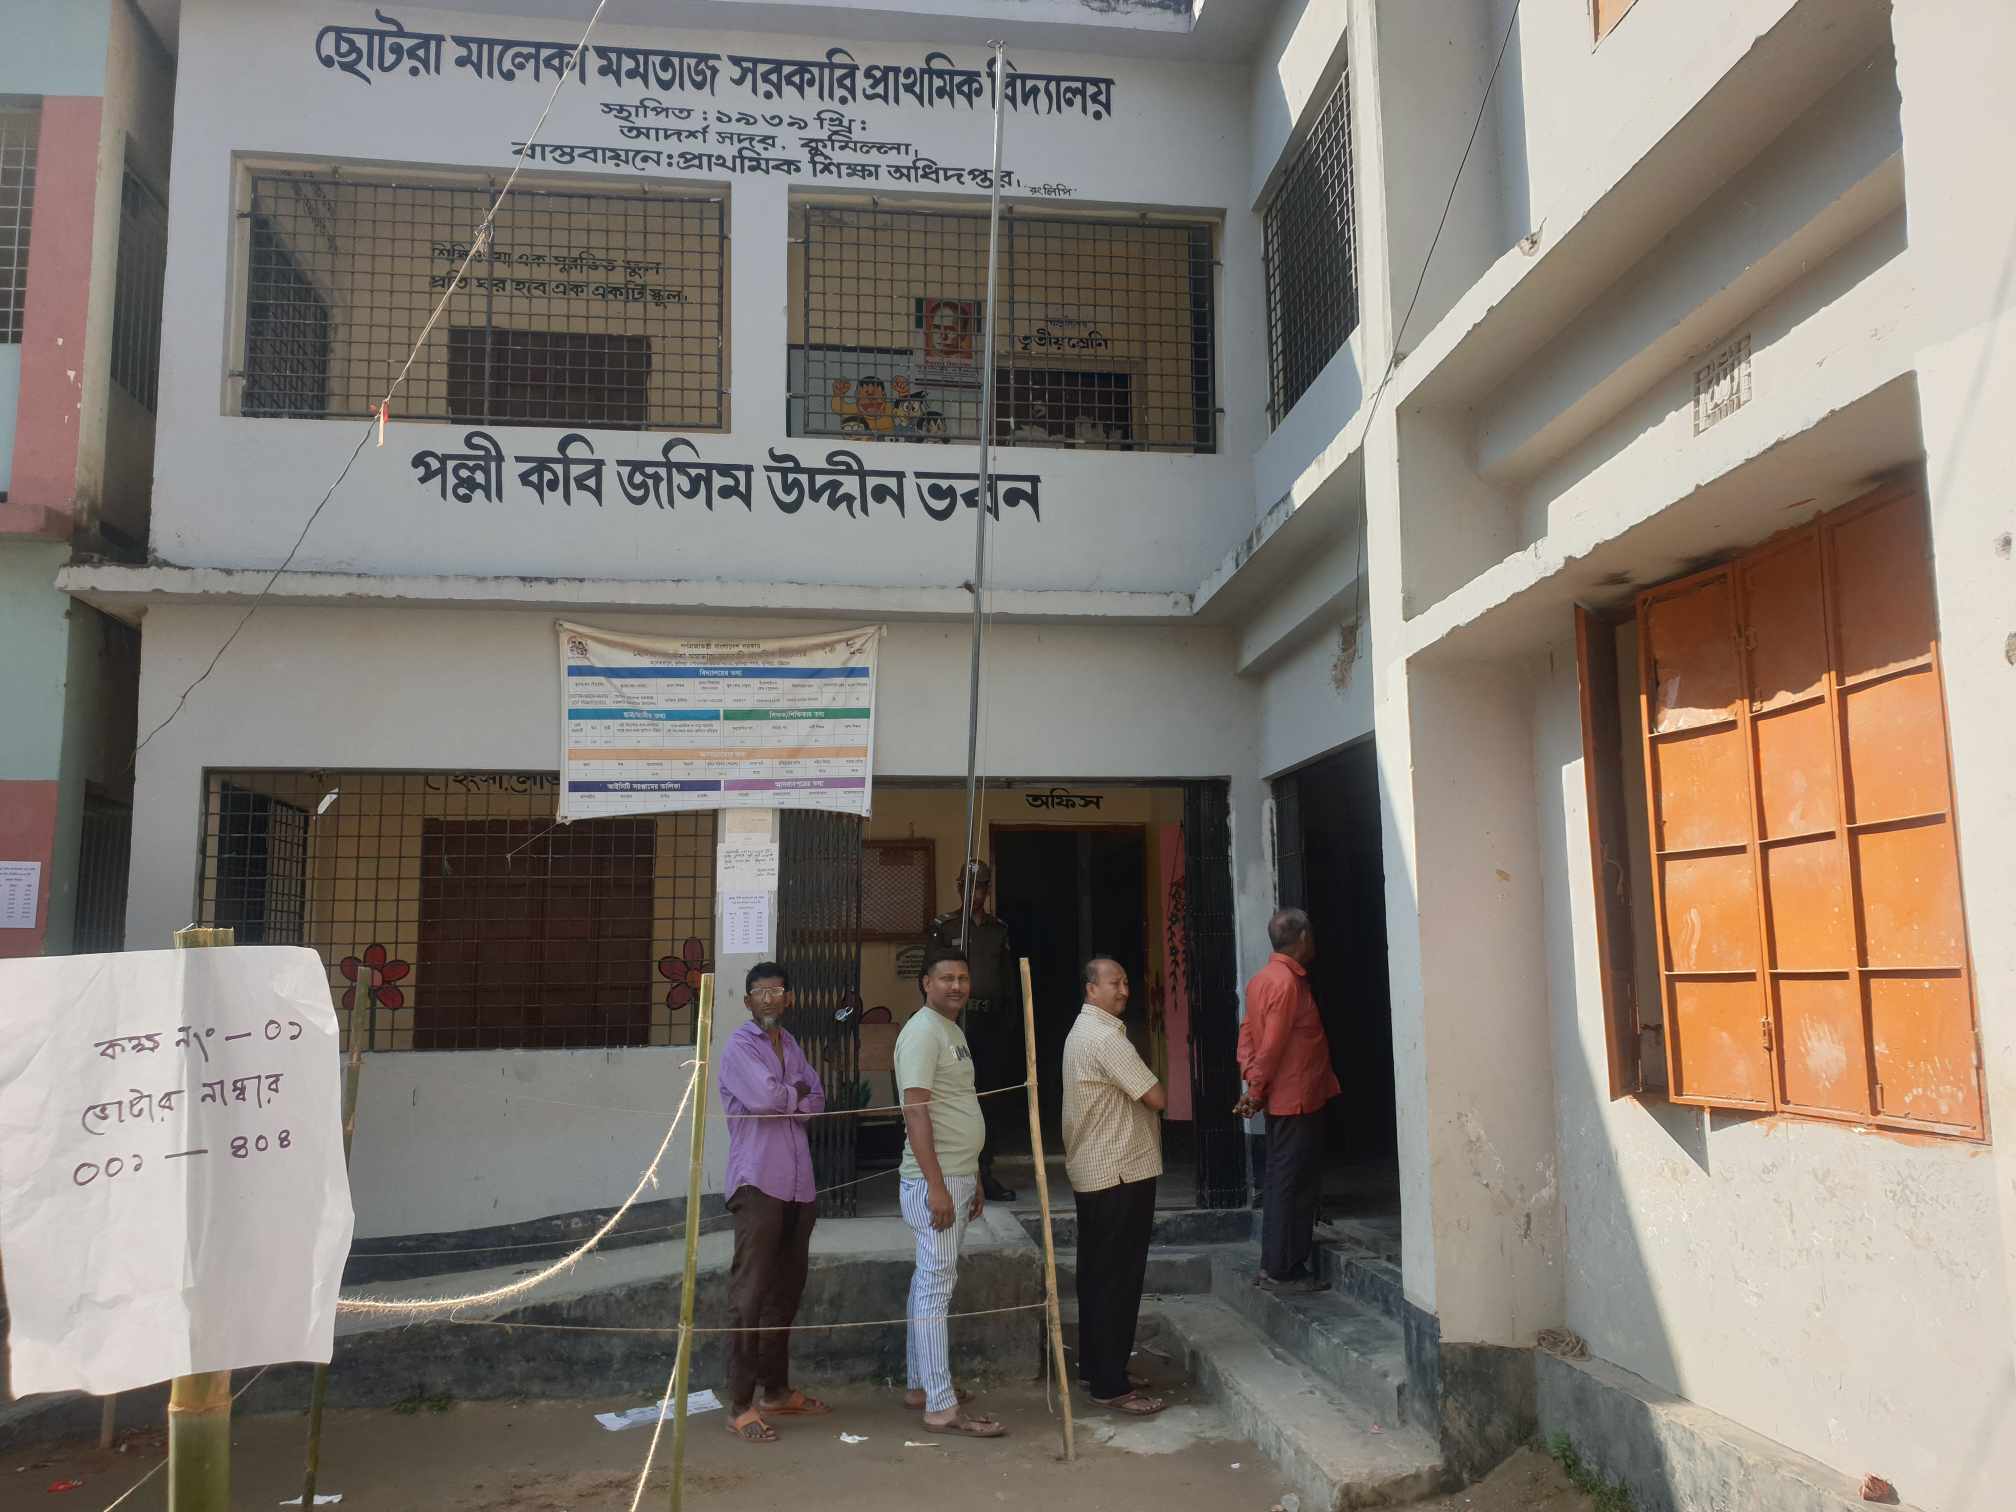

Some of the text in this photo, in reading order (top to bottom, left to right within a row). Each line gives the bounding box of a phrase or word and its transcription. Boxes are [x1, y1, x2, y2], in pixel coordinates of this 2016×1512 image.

[315, 8, 445, 85] ছোটরা
[451, 34, 588, 85] মালেকা
[590, 45, 721, 96] মমতাজ
[727, 47, 859, 106] সরকারি
[863, 51, 983, 110] প্রাথমিক
[716, 110, 809, 130] ১৯৩৯
[619, 124, 710, 145] আদর্শ
[808, 154, 881, 181] শিক্ষা
[551, 282, 586, 298] এক
[411, 431, 1041, 522] পল্লী কবি জসিম উদ্দীন ভবন
[1026, 788, 1103, 810] অফিস
[265, 1019, 302, 1040] ০১
[82, 1088, 184, 1136] ভোটার
[73, 1154, 143, 1186] ০০১
[230, 1129, 291, 1158] ৪০৪
